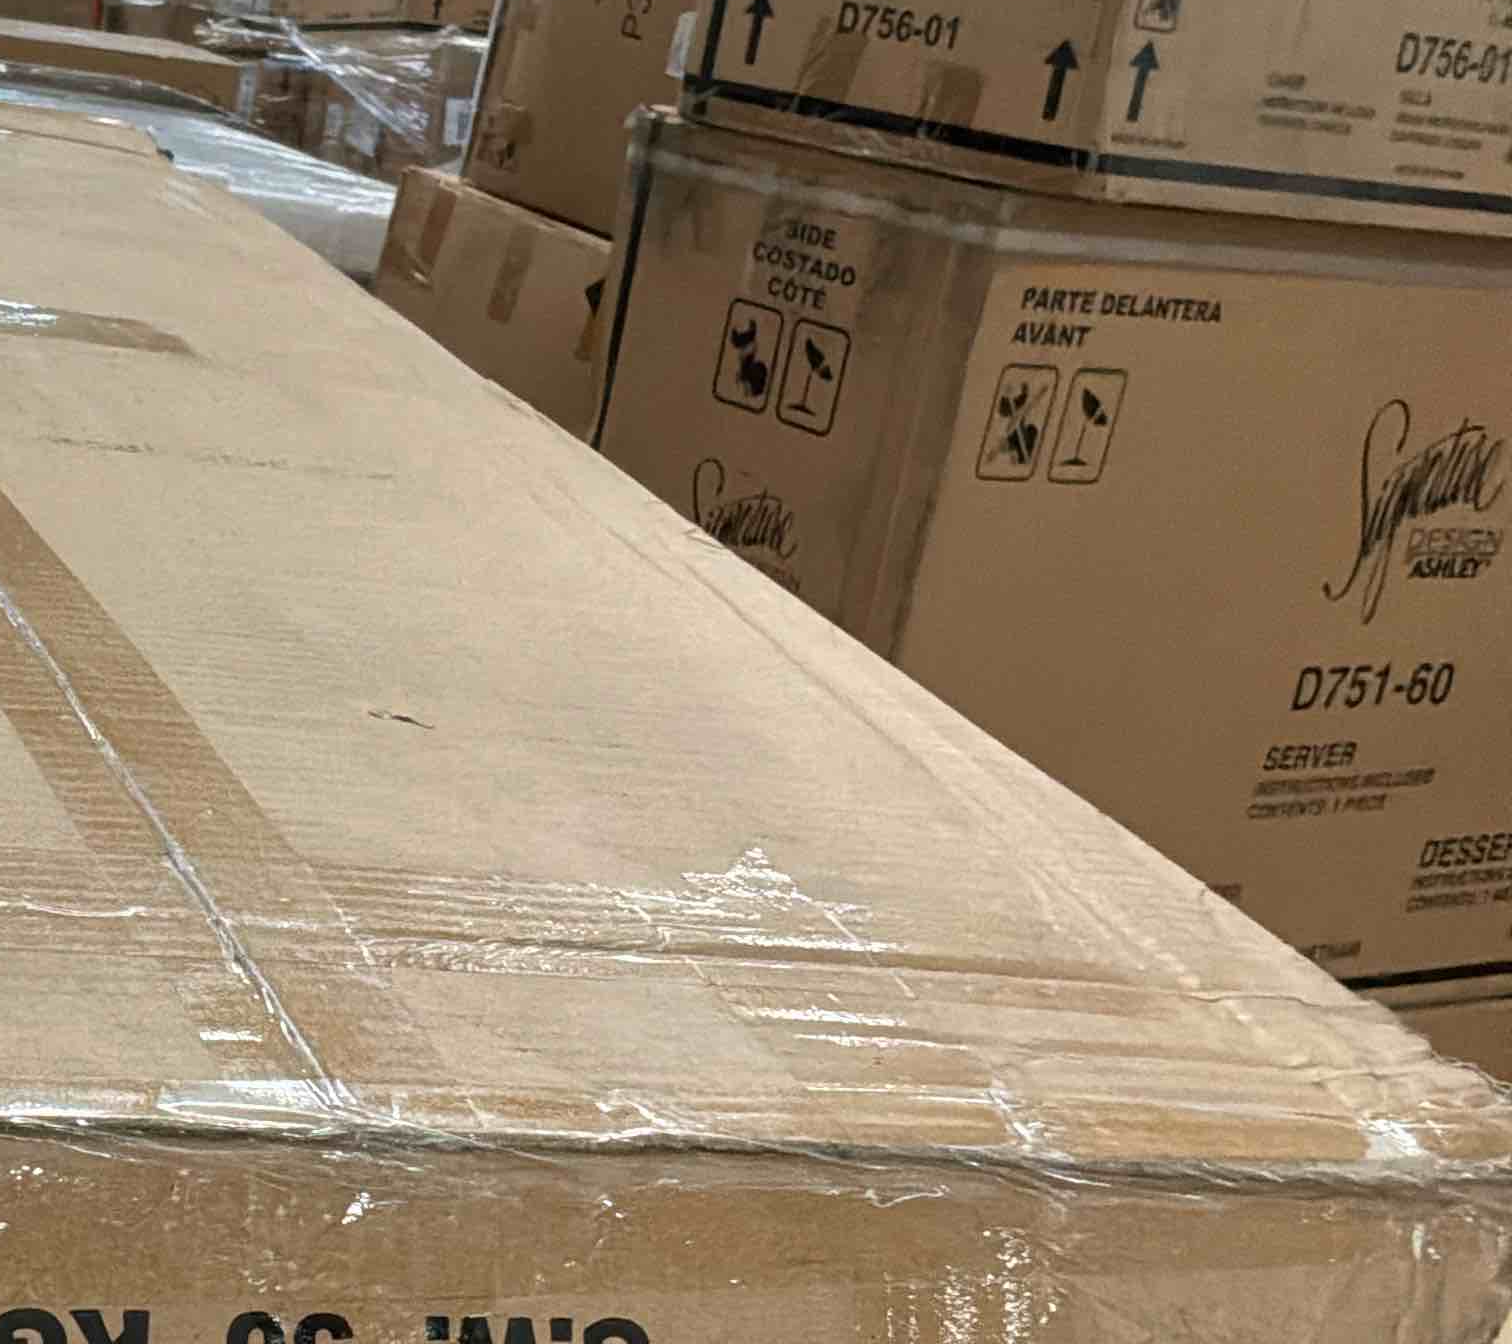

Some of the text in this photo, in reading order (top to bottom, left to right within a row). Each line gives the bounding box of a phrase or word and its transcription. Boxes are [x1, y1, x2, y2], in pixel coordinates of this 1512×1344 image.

[838, 1, 962, 50] D756-01
[1020, 286, 1223, 324] PARTE DELANTERA
[1011, 321, 1094, 348] AVANT
[1290, 661, 1455, 712] D751-60
[1262, 741, 1357, 771] SERVER
